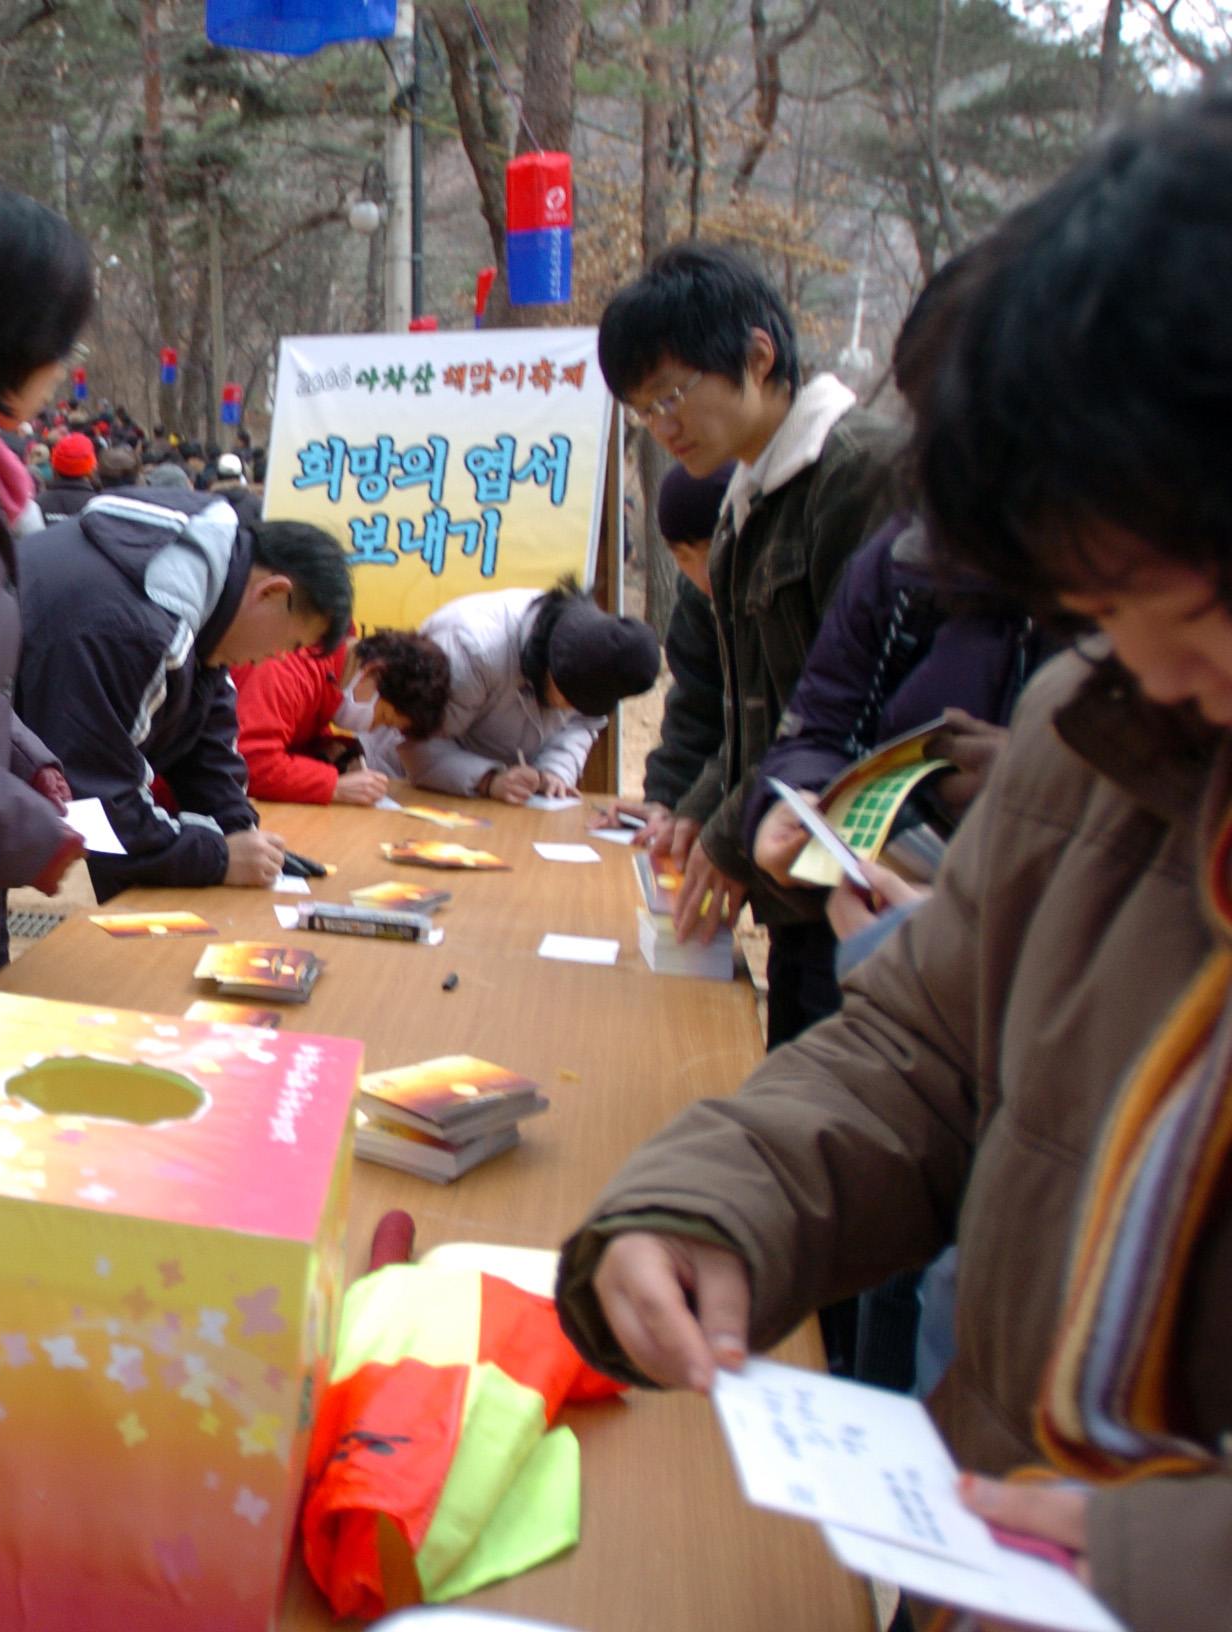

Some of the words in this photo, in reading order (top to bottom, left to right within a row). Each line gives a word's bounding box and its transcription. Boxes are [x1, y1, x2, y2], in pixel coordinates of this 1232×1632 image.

[355, 361, 436, 395] 아차산
[442, 357, 587, 396] 해맞이축제
[293, 434, 449, 504] 희망의
[465, 433, 572, 506] 엽서
[346, 506, 502, 577] 보내기
